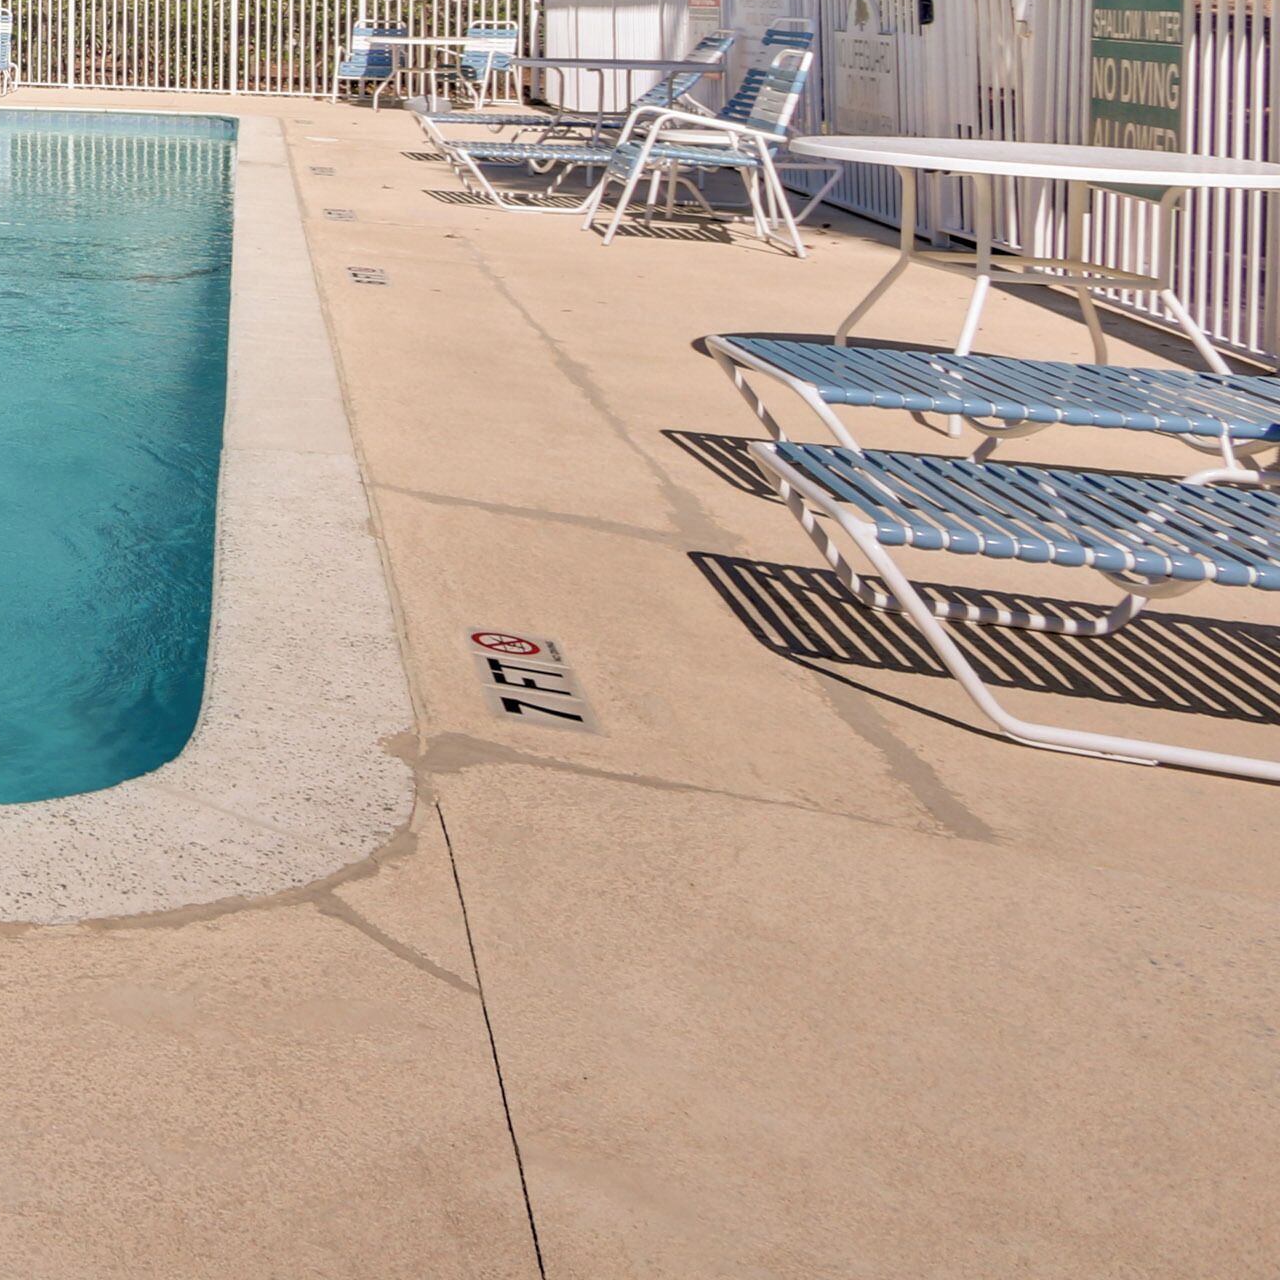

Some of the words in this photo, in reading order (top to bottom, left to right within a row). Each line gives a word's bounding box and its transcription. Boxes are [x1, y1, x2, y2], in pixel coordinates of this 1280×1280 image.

[1093, 8, 1141, 40] SHALLOW
[1145, 10, 1181, 43] WATER
[1092, 56, 1116, 101] NO
[1120, 59, 1180, 110] DIVING
[486, 657, 572, 696] FT
[500, 696, 584, 723] 7
